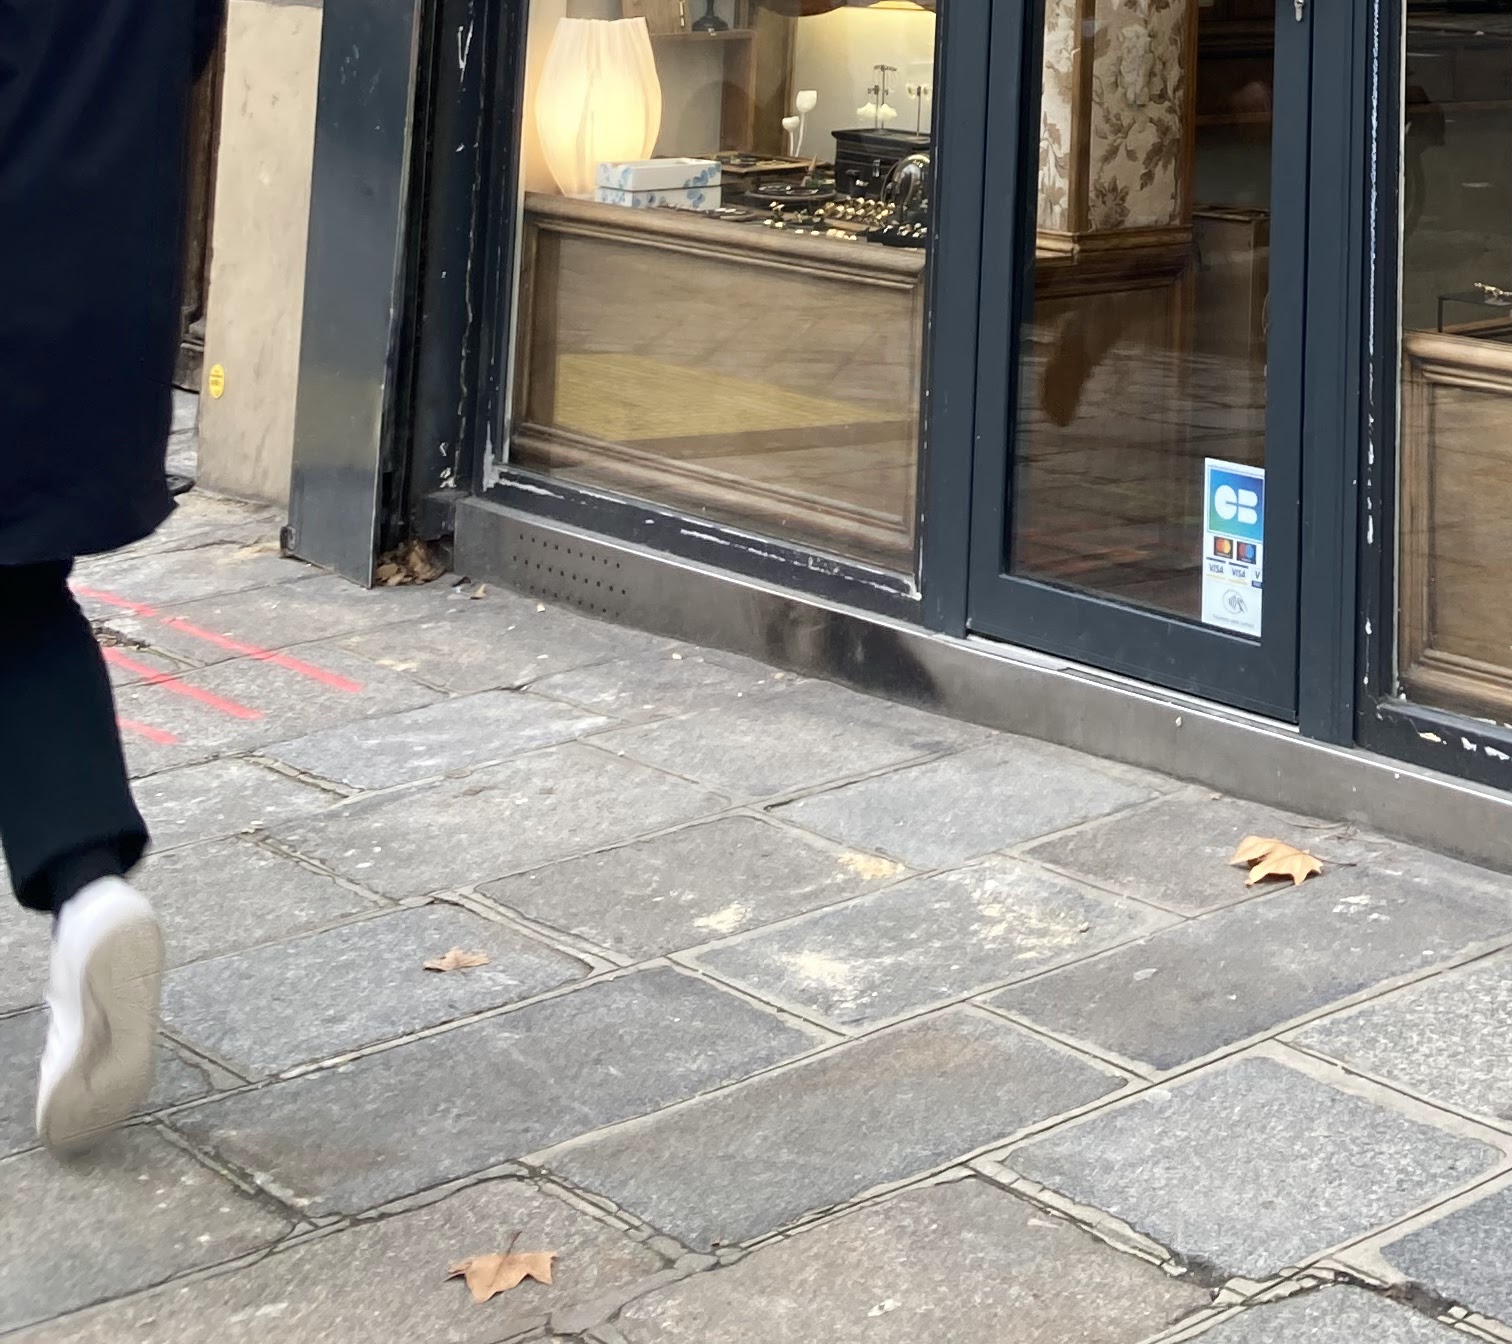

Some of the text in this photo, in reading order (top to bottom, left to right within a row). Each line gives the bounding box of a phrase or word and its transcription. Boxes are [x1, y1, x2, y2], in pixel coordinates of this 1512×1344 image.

[1214, 484, 1259, 526] CB
[1209, 563, 1224, 574] VISA
[1231, 567, 1246, 578] VISA
